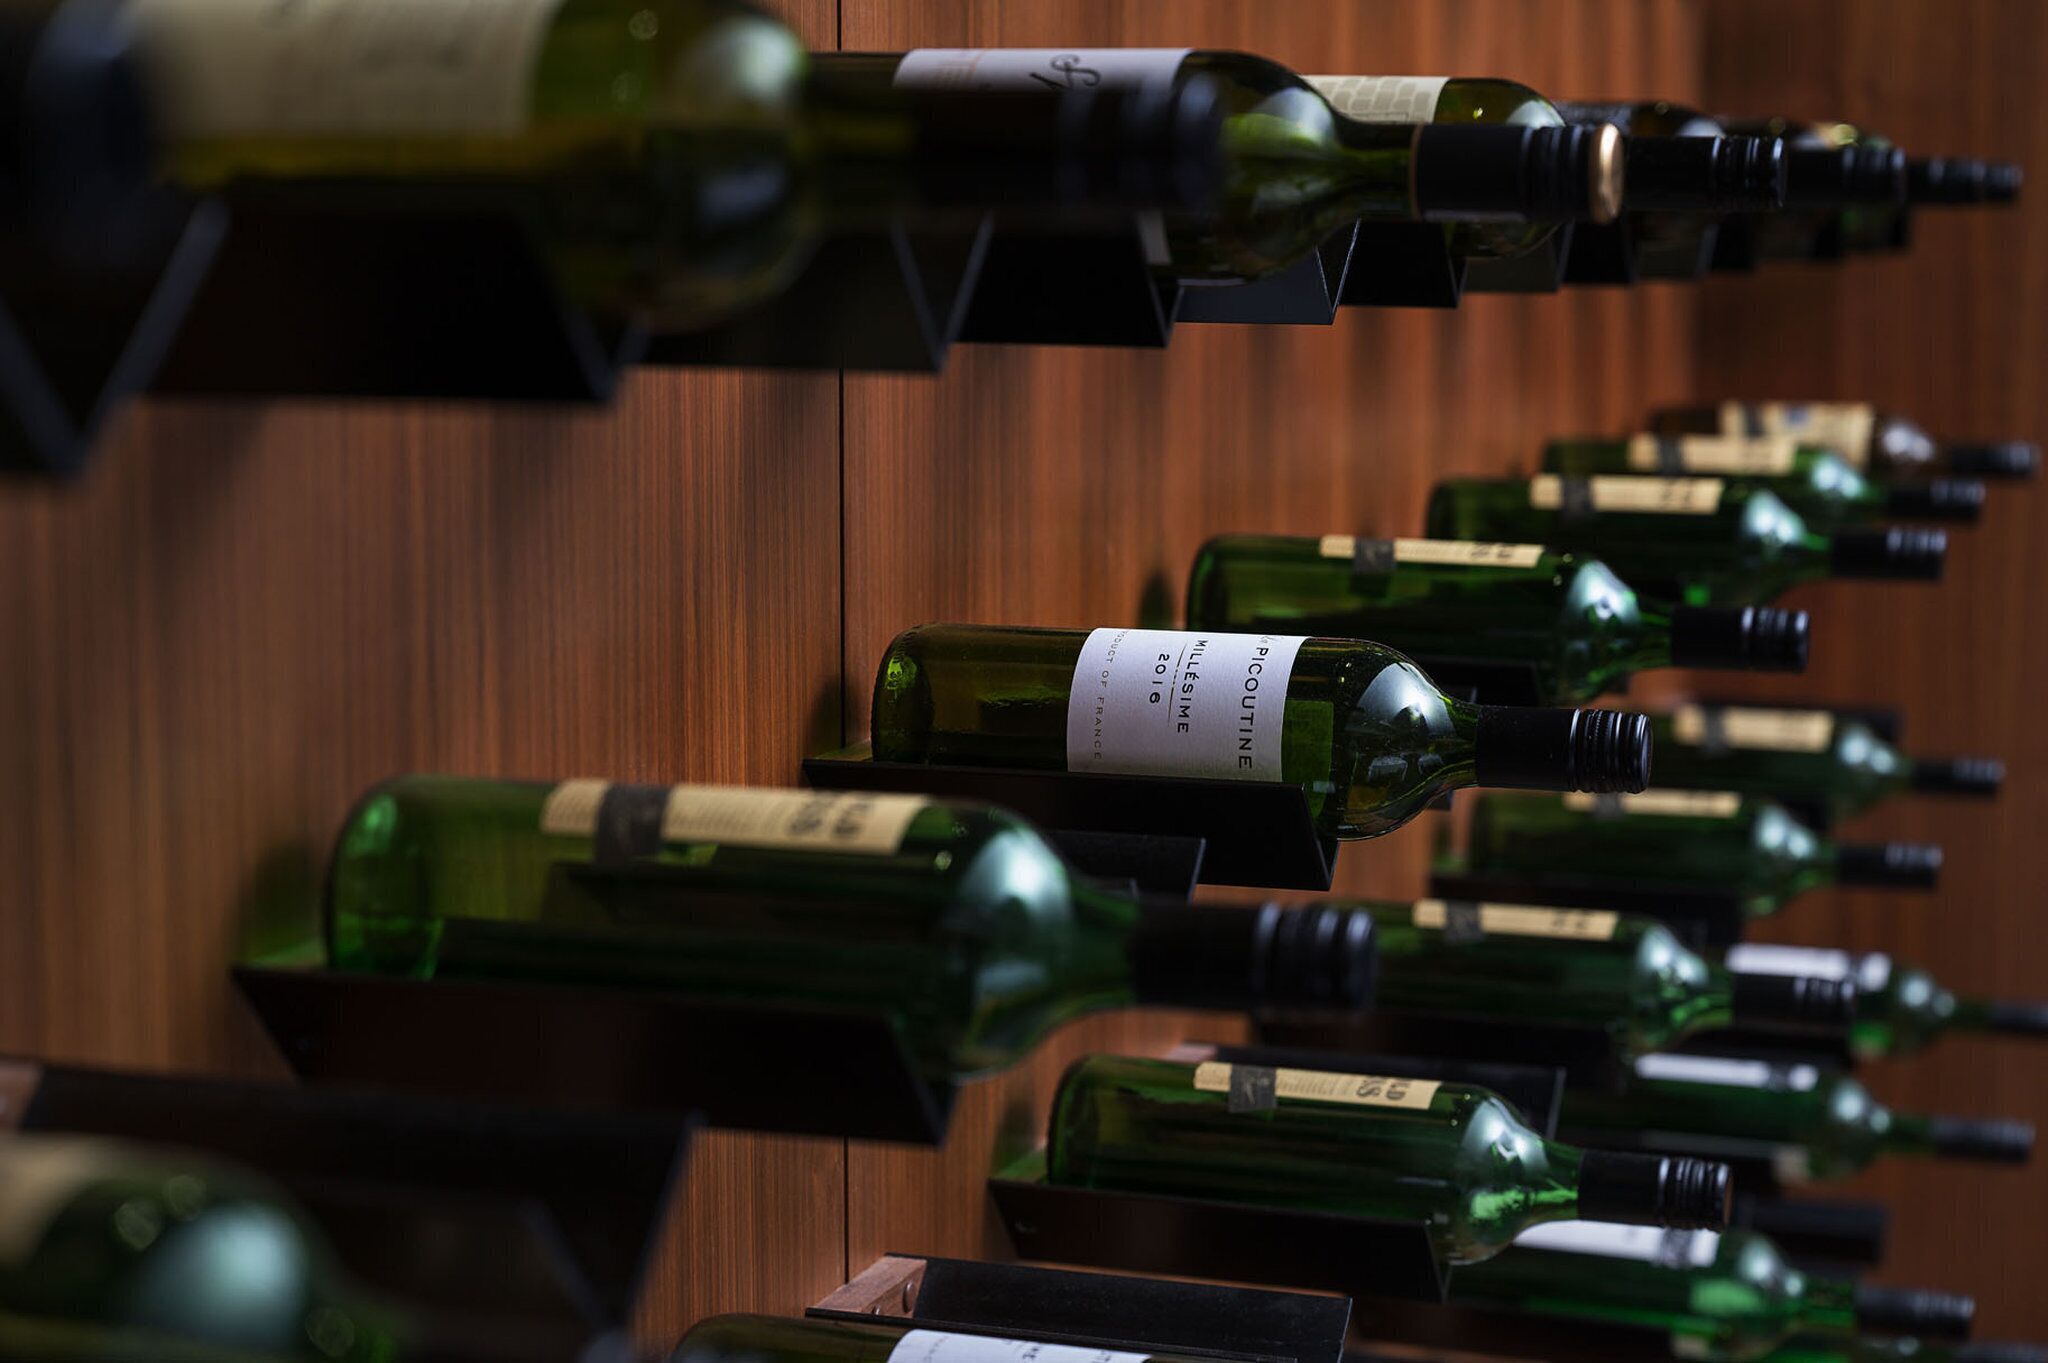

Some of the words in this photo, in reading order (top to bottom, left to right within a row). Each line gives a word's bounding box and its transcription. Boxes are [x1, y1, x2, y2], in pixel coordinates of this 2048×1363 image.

[1106, 631, 1129, 663] RODUCT
[1100, 670, 1109, 688] OF
[1149, 653, 1170, 704] 2016
[1177, 639, 1209, 733] MILLÉSIME
[1093, 696, 1105, 760] FRANCE
[1238, 646, 1269, 769] PICOUTINE
